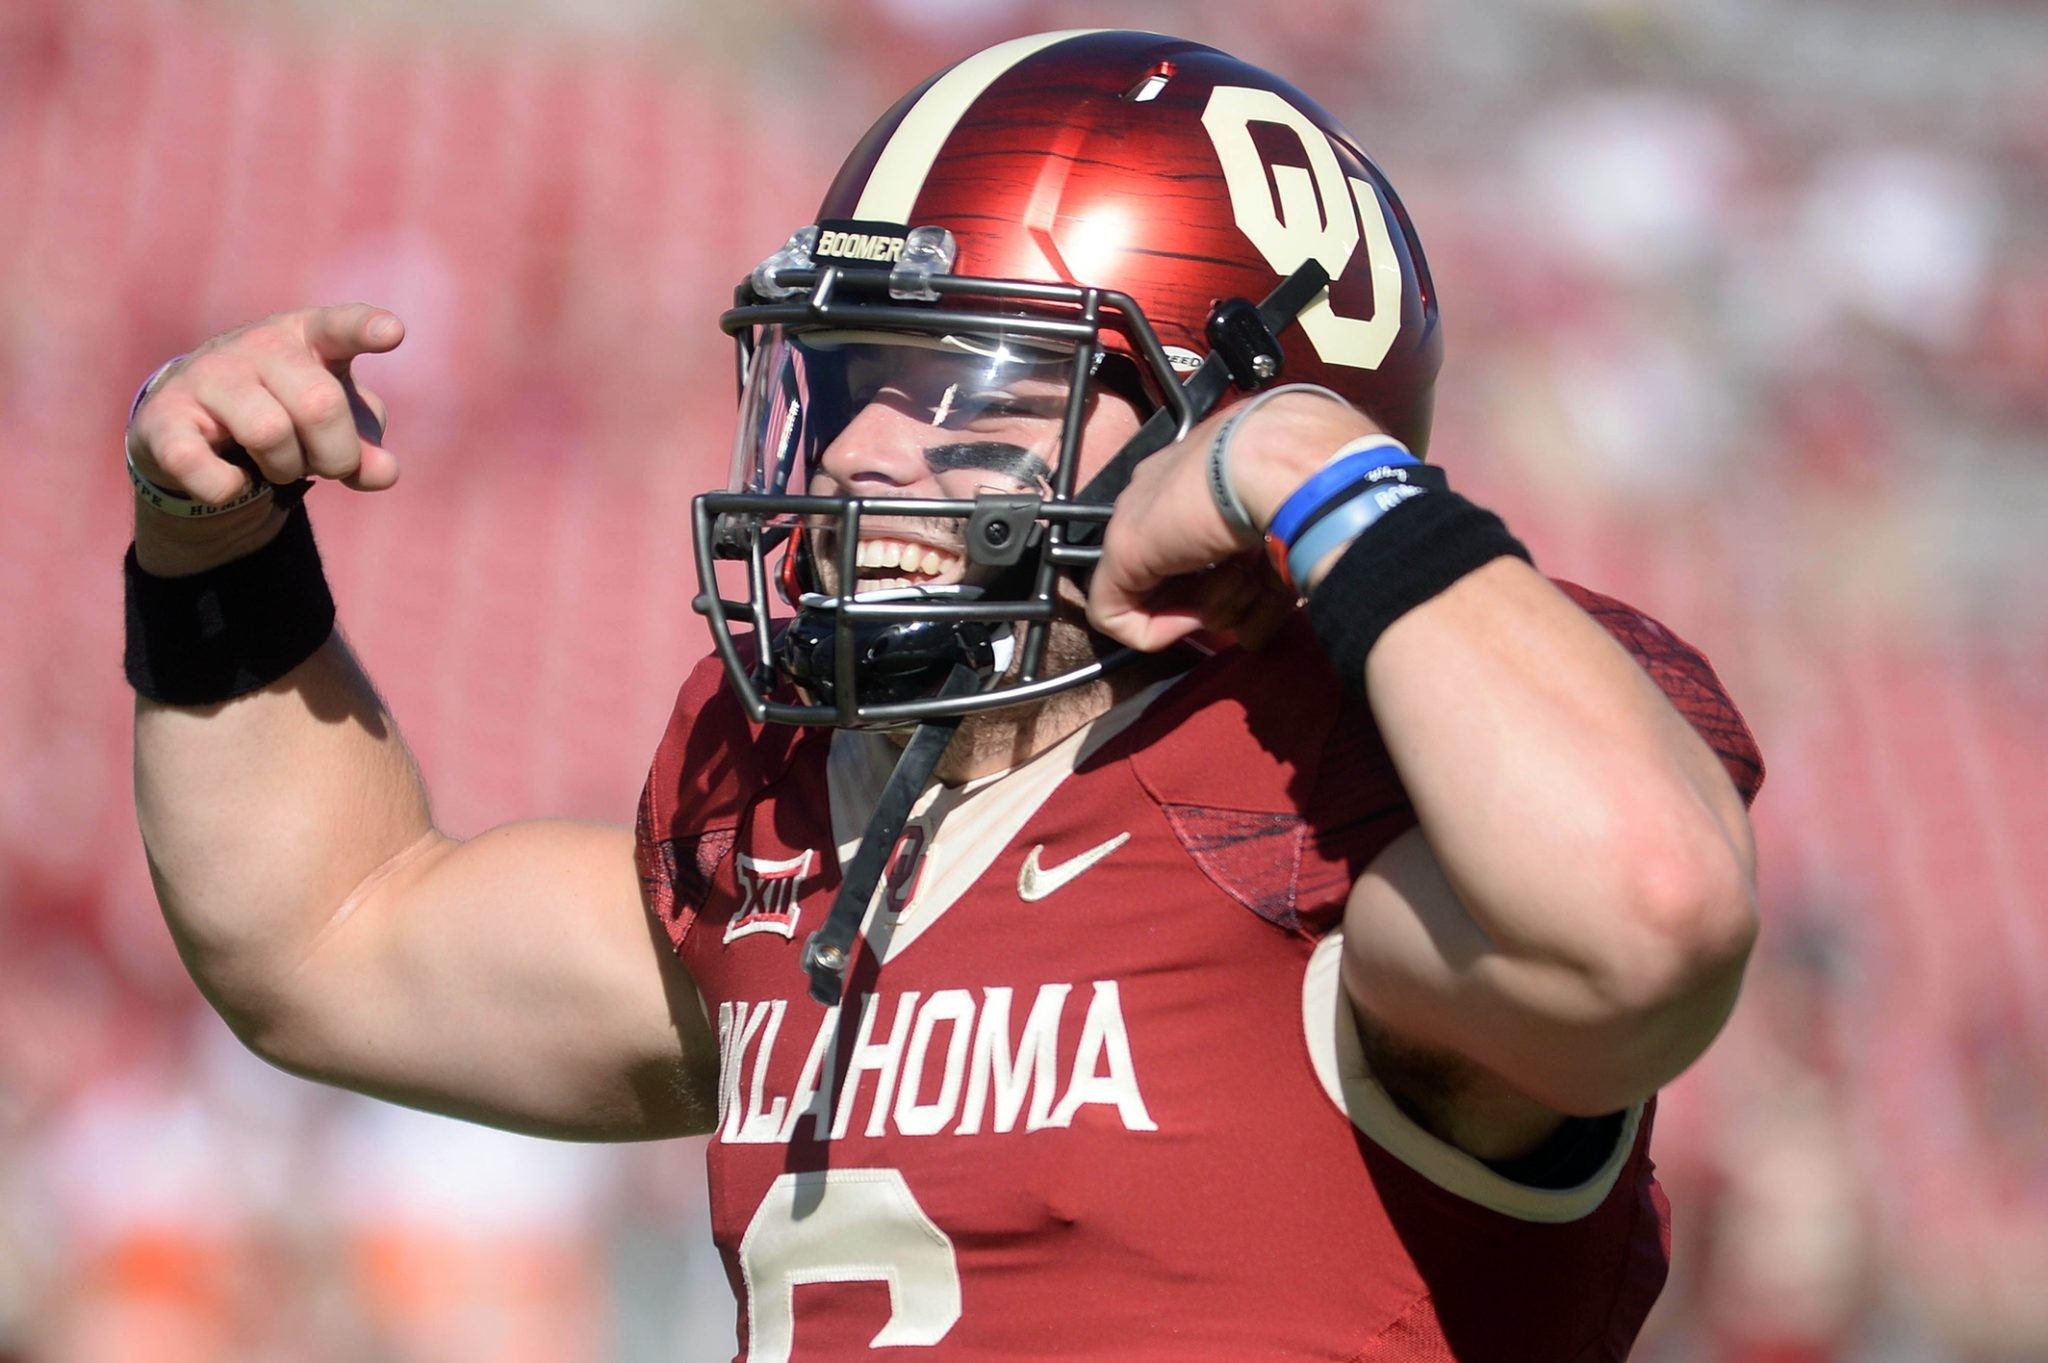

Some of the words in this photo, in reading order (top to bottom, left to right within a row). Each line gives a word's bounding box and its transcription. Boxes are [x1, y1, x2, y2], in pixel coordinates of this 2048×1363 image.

[1200, 85, 1402, 371] OU
[817, 230, 904, 262] BOOMER
[1169, 354, 1201, 368] EED
